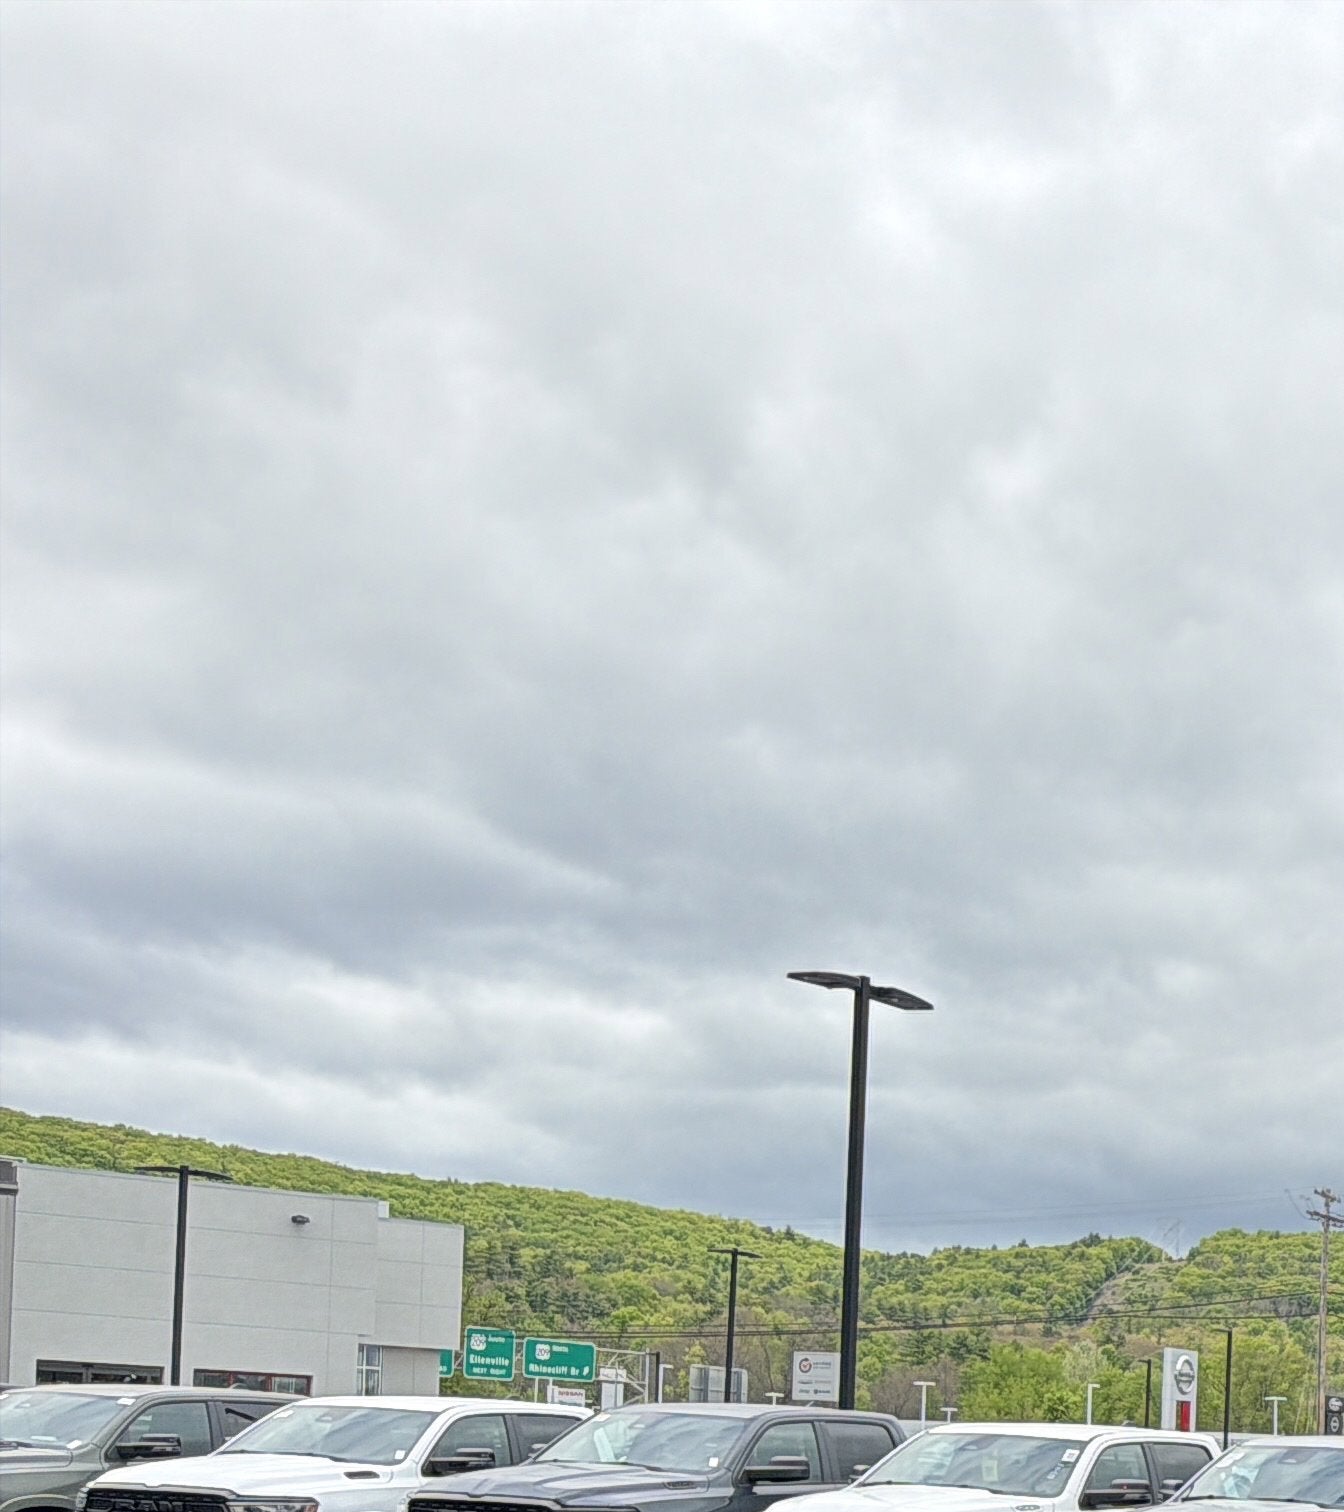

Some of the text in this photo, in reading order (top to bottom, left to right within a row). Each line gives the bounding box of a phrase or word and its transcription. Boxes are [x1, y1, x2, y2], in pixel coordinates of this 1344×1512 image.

[471, 1335, 487, 1348] 209
[537, 1347, 550, 1357] 209
[469, 1354, 510, 1367] Ellenville
[528, 1363, 568, 1375] Rhinecliff
[115, 1500, 184, 1512] RAM
